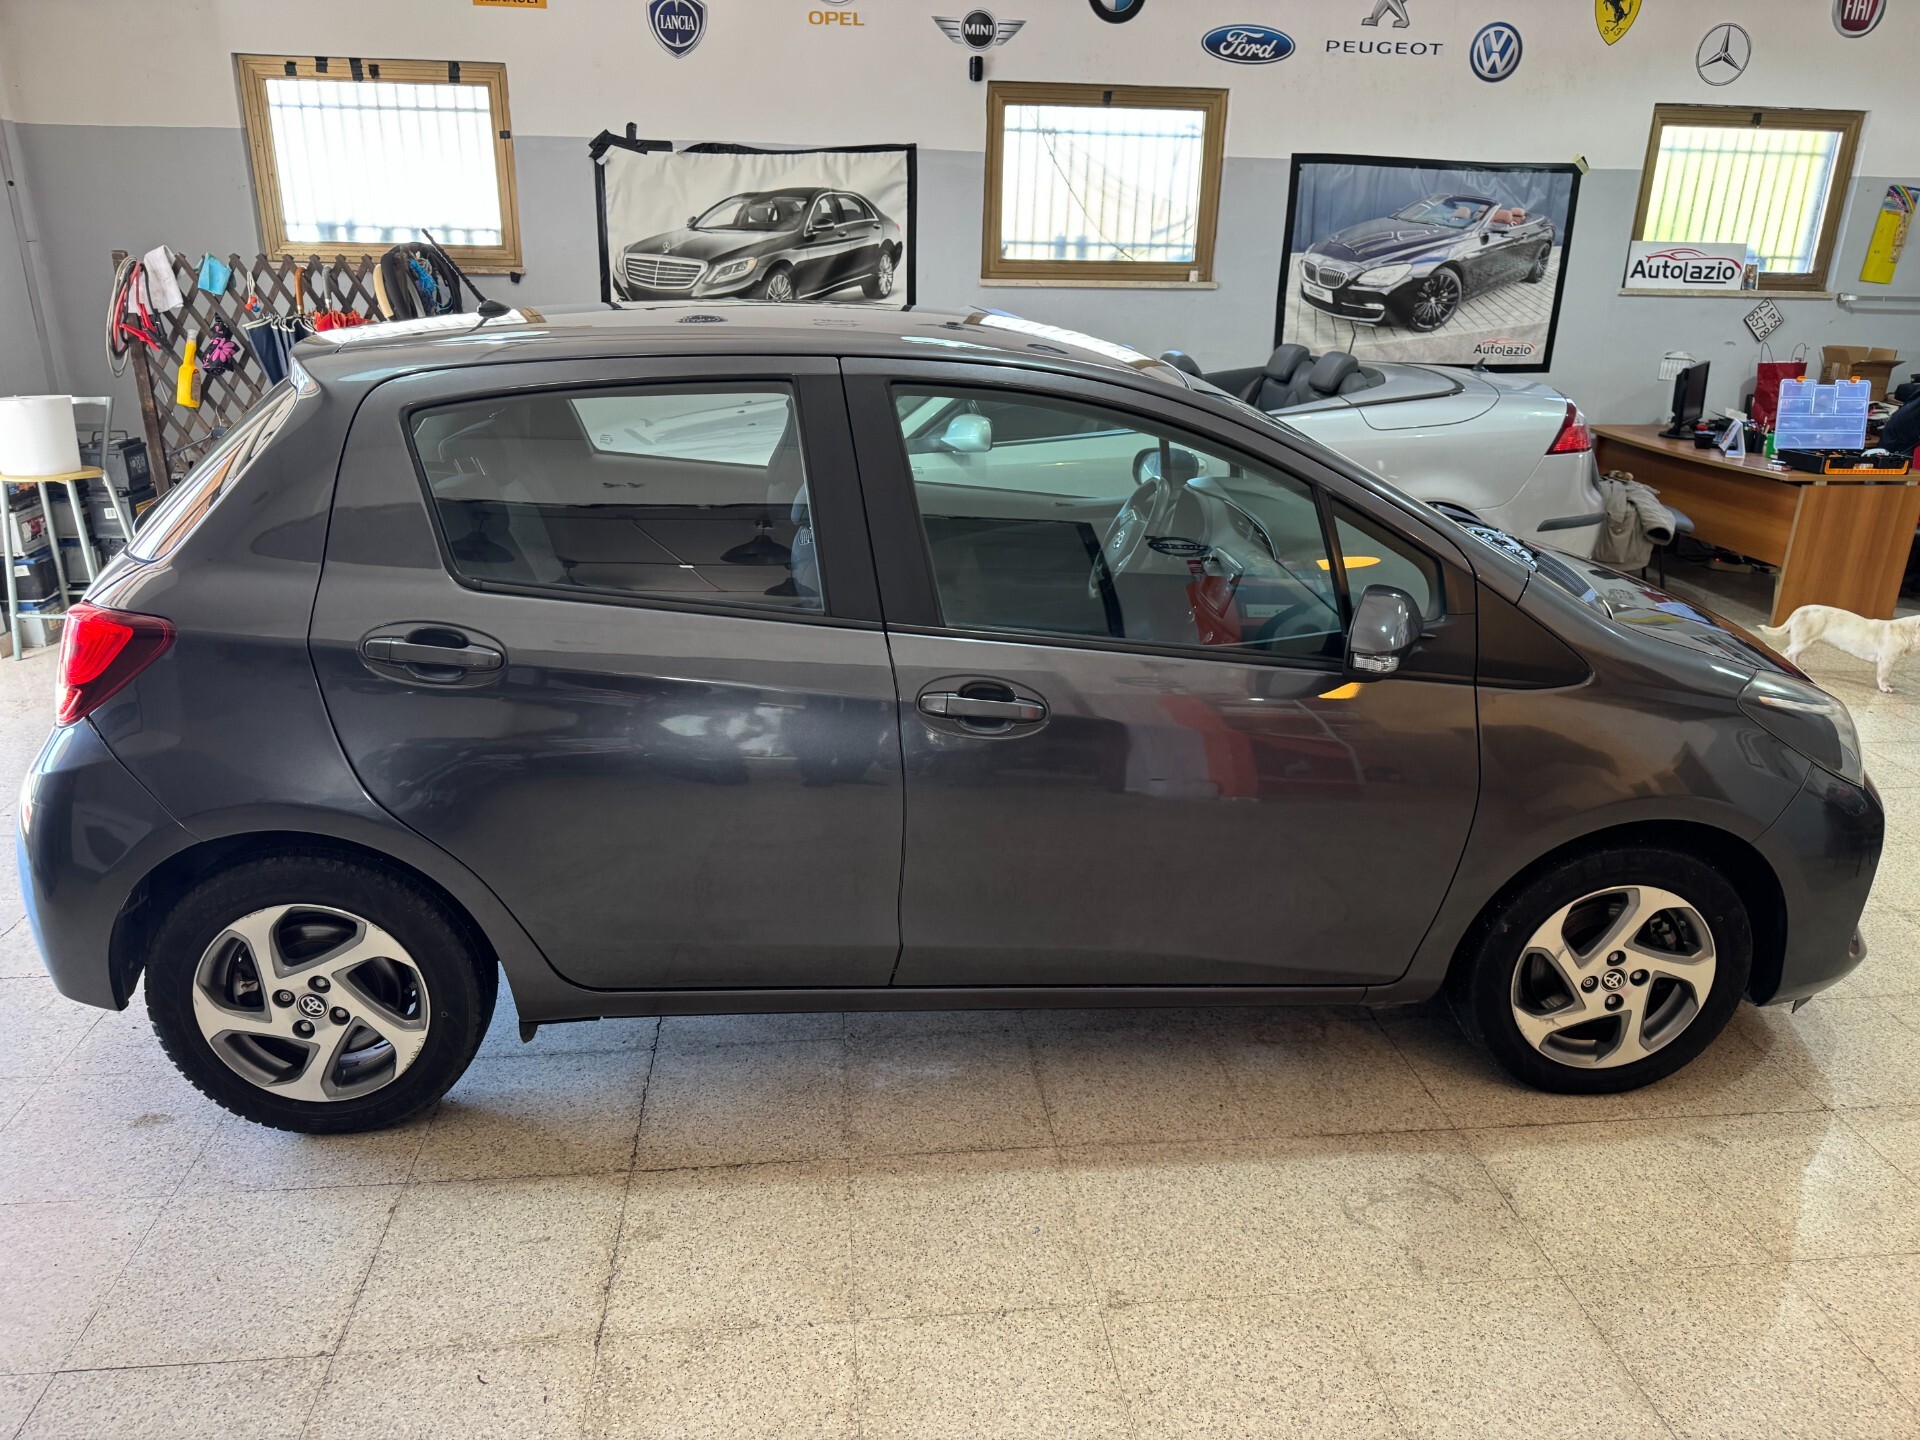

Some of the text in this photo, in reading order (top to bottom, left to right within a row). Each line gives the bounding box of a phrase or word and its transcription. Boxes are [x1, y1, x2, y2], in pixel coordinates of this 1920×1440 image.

[660, 14, 696, 30] LANCIA
[808, 11, 865, 26] OPEL
[964, 23, 993, 36] MINI
[1219, 30, 1278, 58] Ford
[1325, 40, 1444, 55] PEUGEOT
[1630, 259, 1736, 284] AutoLazio
[1747, 311, 1770, 338] 6578
[1473, 343, 1532, 357] AutoLazio
